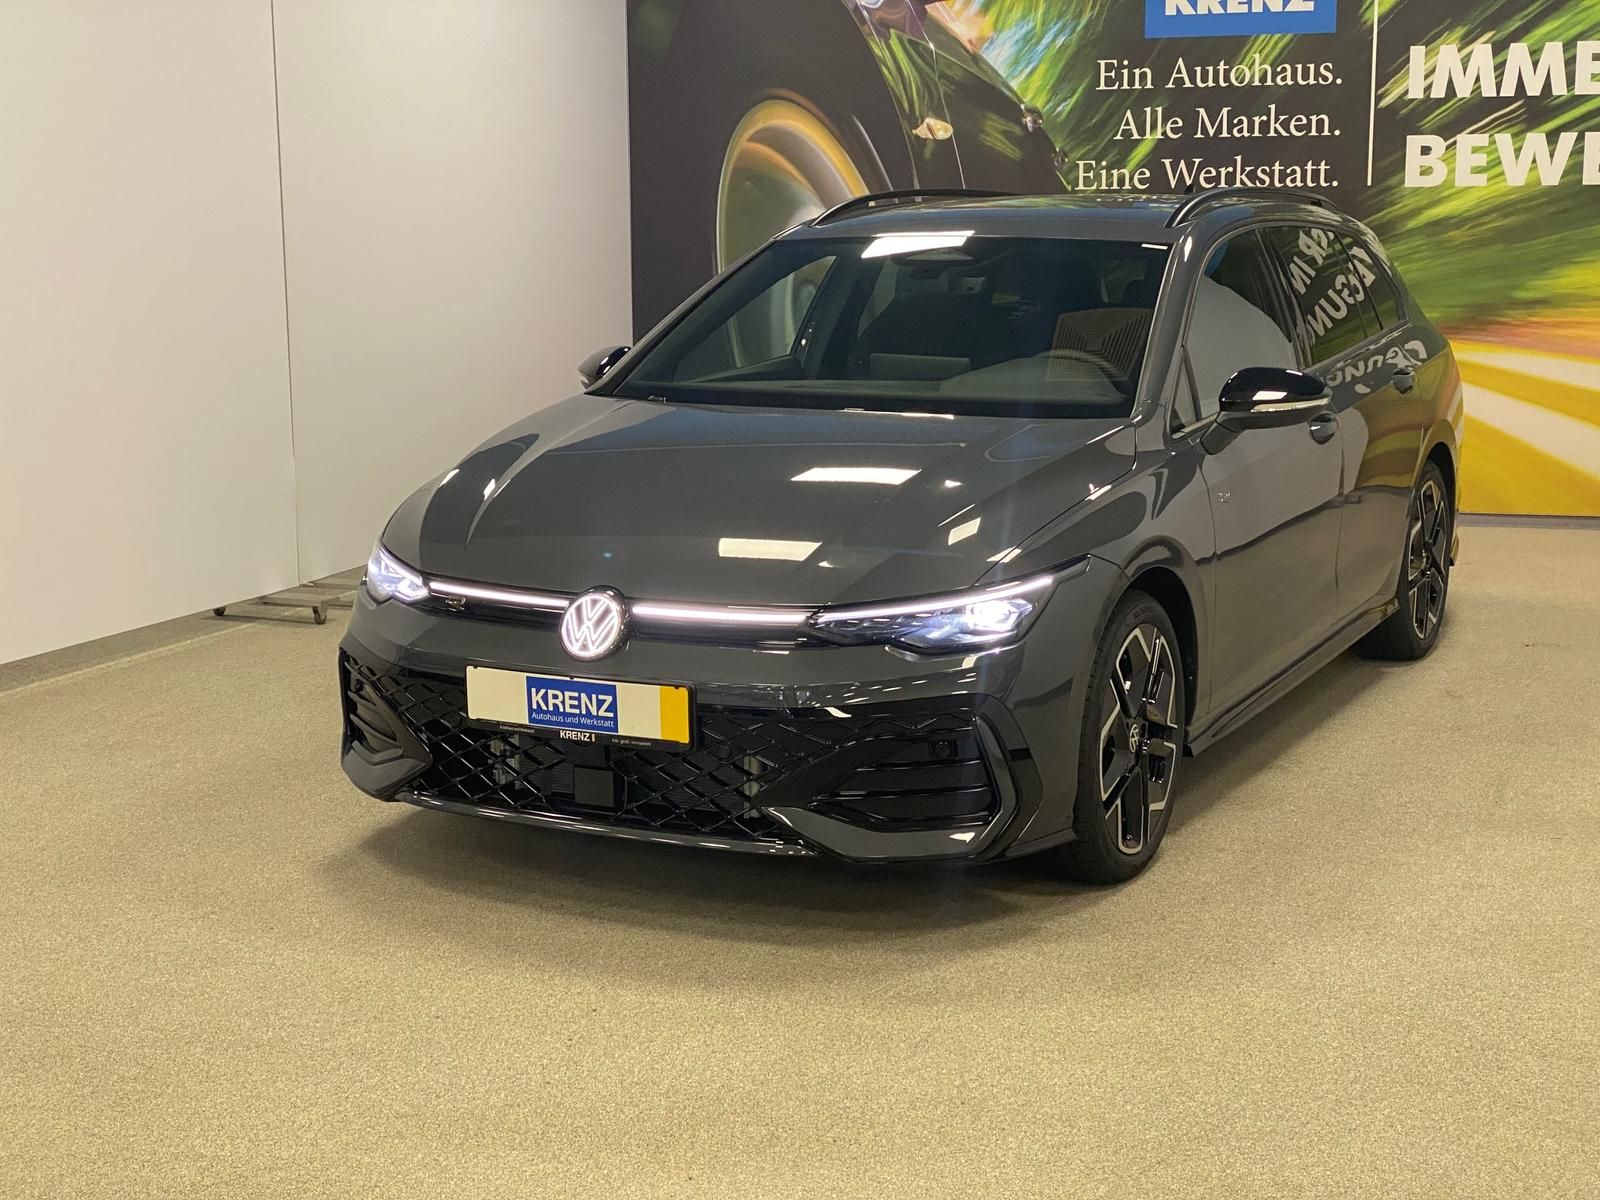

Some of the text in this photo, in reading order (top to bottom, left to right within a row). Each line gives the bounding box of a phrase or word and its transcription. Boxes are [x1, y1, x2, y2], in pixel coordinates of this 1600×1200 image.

[1095, 53, 1343, 91] Ein Autohaus.
[1113, 103, 1341, 140] Alle Marken.
[1074, 155, 1339, 191] Eine Werkstatt.
[531, 687, 614, 718] KRENZ
[531, 711, 614, 728] Autohaus und Werkstatt
[560, 729, 590, 742] KRENZ
